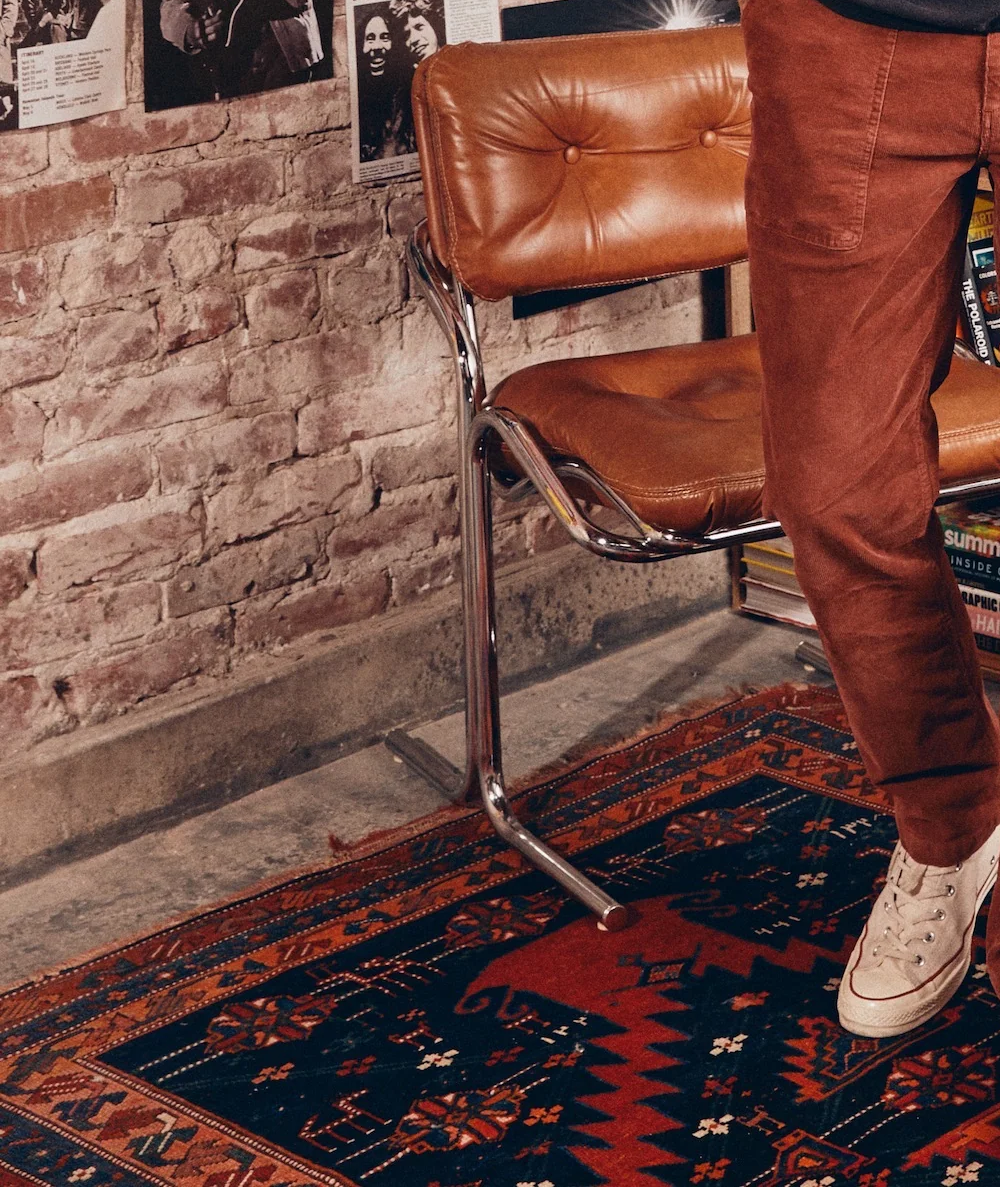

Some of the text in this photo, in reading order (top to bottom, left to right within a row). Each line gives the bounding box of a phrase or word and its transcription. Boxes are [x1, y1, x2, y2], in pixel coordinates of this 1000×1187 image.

[962, 278, 976, 302] THE
[967, 302, 988, 359] POLAROID
[951, 555, 992, 573] INSIDE
